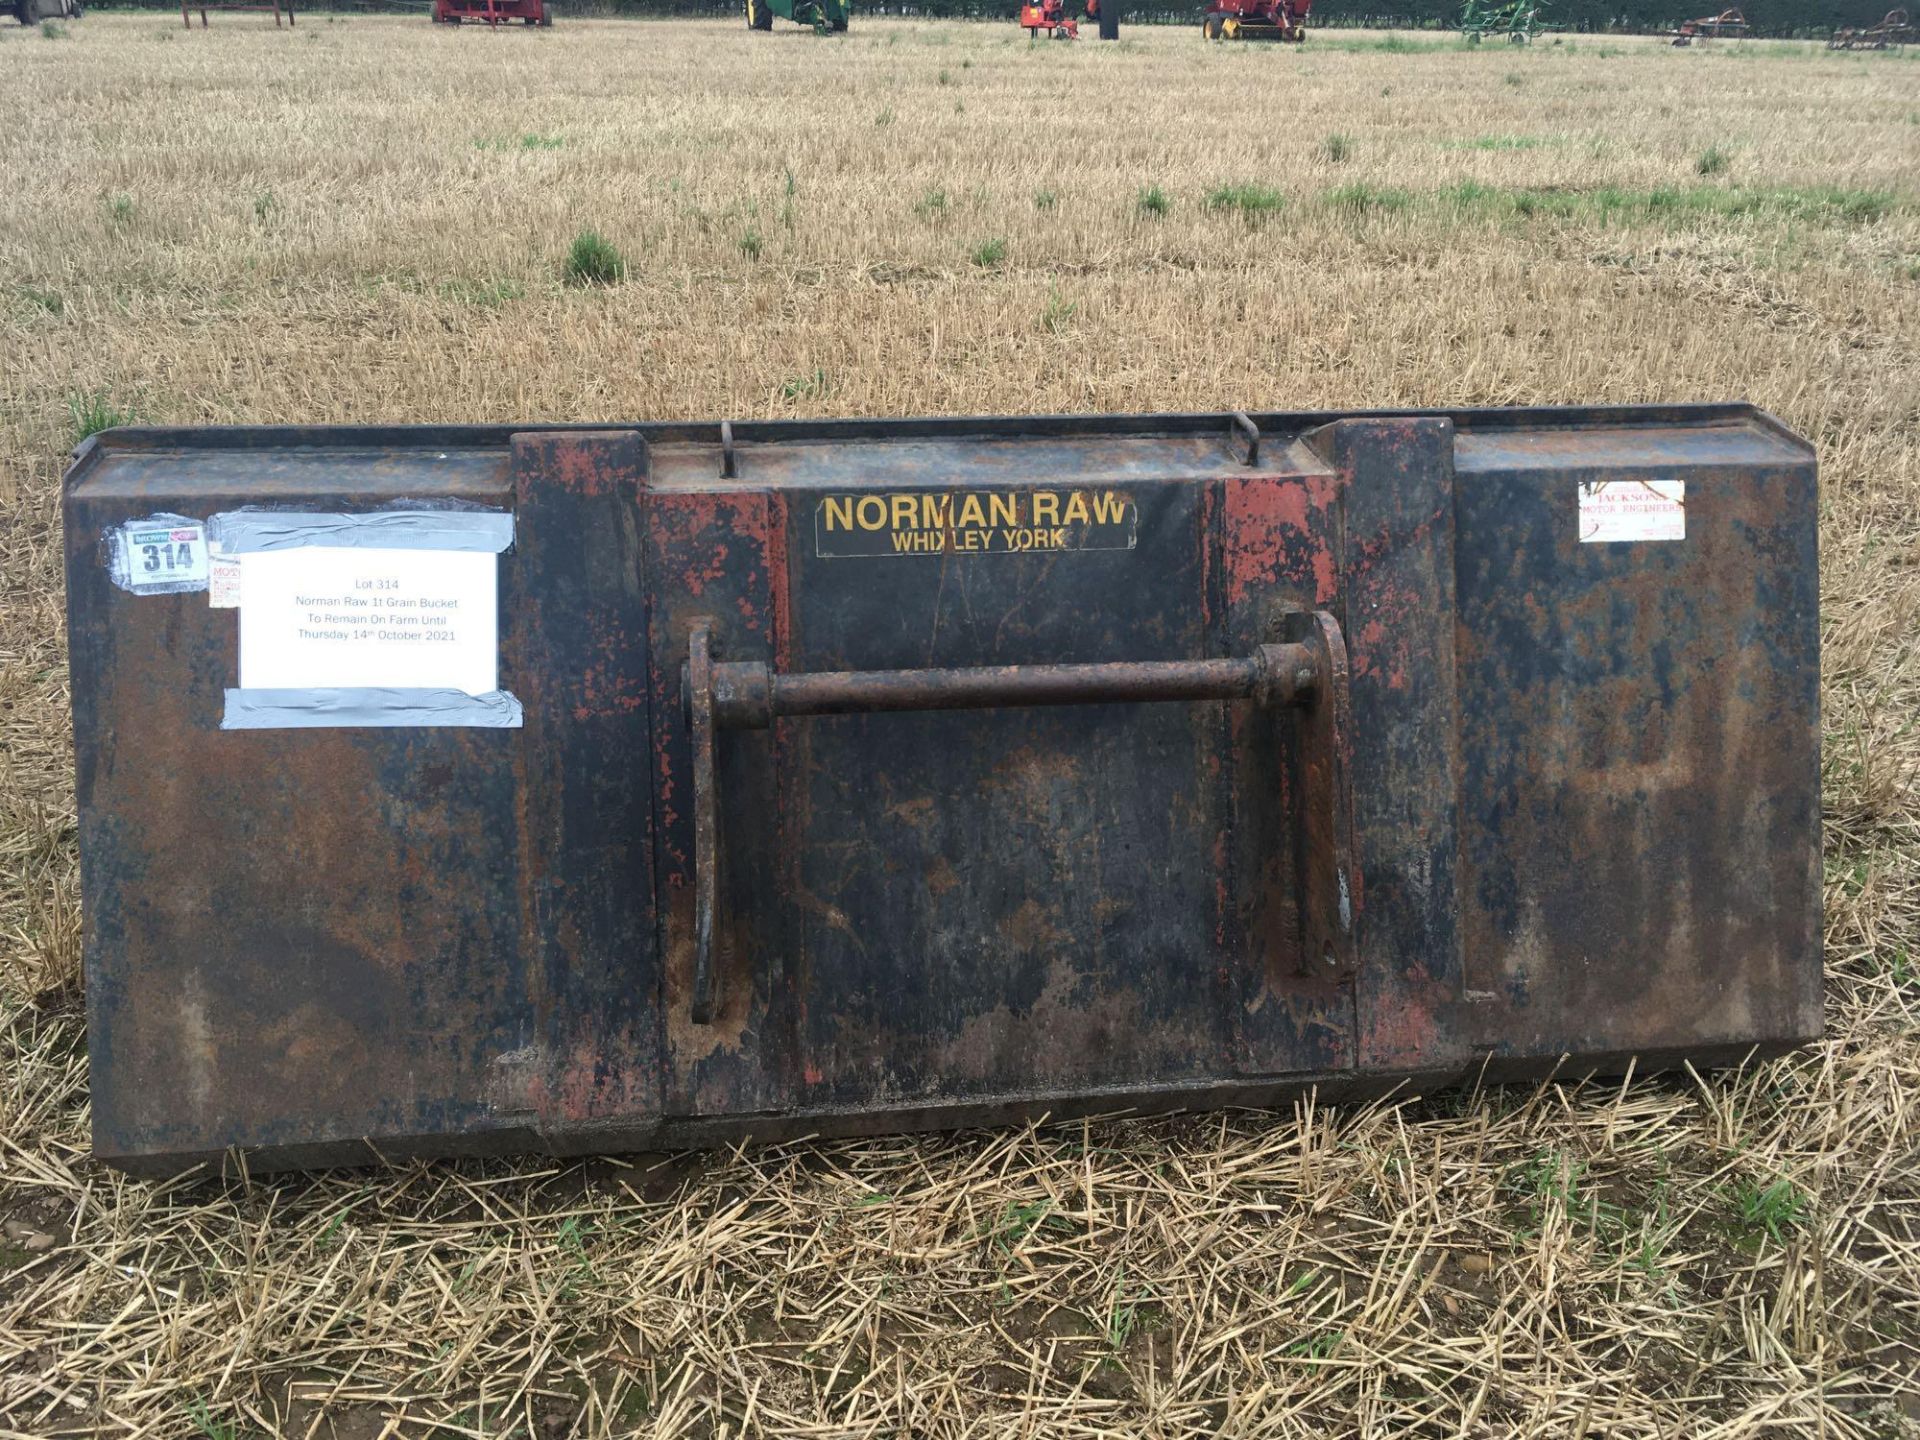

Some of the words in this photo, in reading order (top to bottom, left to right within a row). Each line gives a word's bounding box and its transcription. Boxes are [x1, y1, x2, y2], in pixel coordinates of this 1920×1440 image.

[824, 494, 1016, 531] NORMAN
[1032, 490, 1126, 526] RAW
[1582, 504, 1616, 514] MOTOR
[1622, 503, 1682, 513] ENGINEERS
[892, 529, 994, 552] WHIXLEY
[1003, 528, 1066, 550] YORK
[142, 542, 194, 572] 314
[213, 567, 241, 577] MOT
[355, 578, 373, 590] Lot
[376, 579, 399, 590] 314
[295, 595, 341, 607] Norman
[343, 596, 368, 607] Raw
[371, 597, 383, 607] 1t
[386, 597, 417, 608] Grain
[419, 597, 459, 609] Bucket
[307, 612, 322, 624] To
[324, 613, 368, 624] Remain
[370, 614, 386, 625] On
[389, 614, 418, 625] Farm
[421, 615, 447, 626] Until
[298, 628, 350, 641] Thursday
[353, 629, 376, 640] 14th
[377, 630, 422, 641] October
[425, 630, 456, 641] 2021
